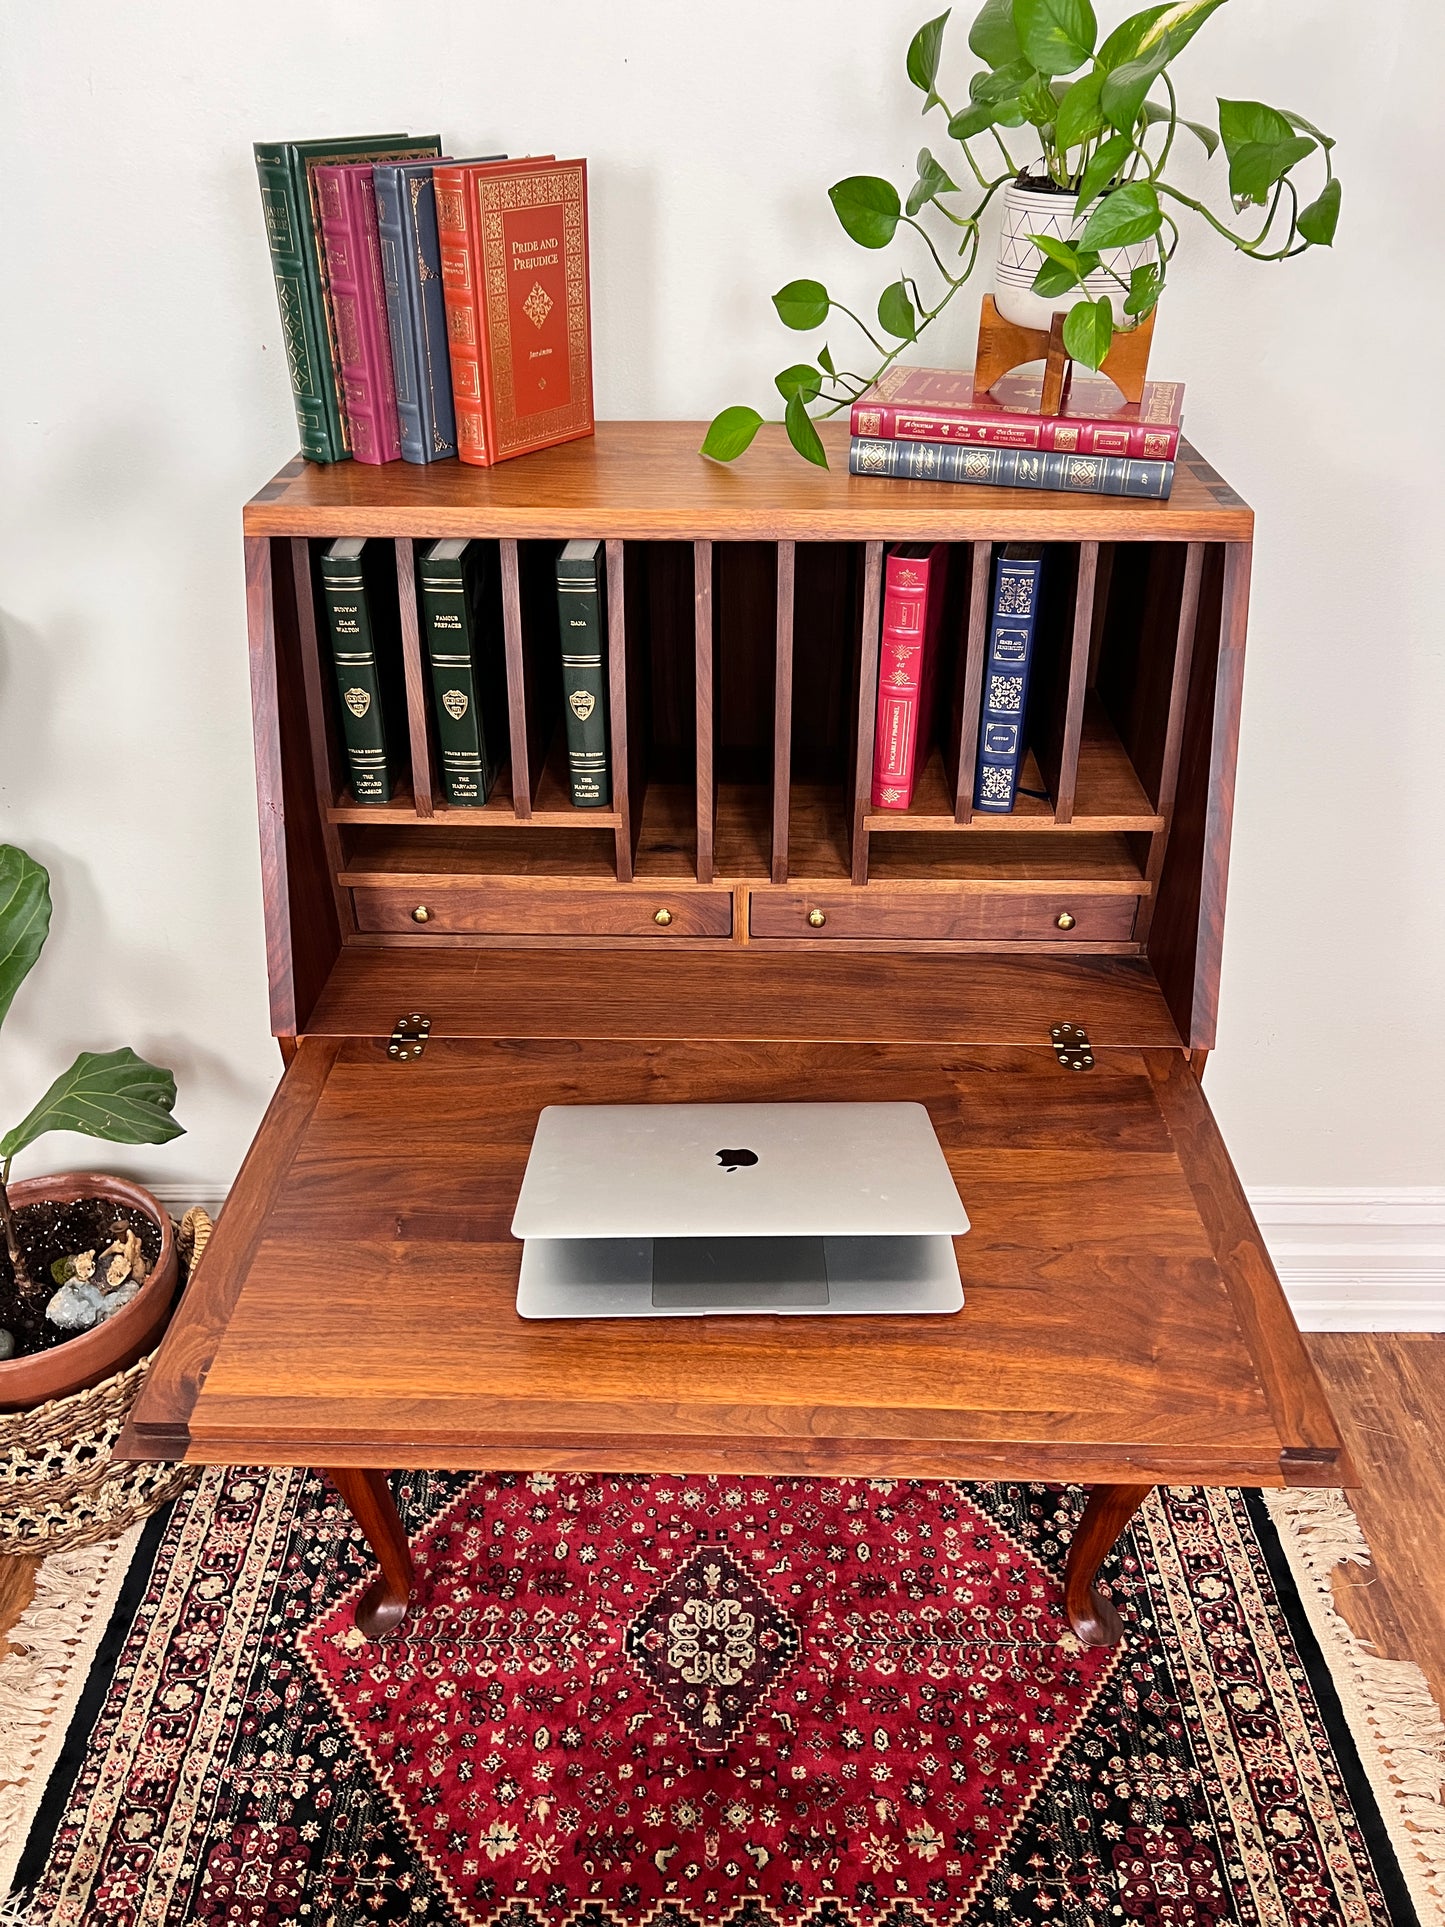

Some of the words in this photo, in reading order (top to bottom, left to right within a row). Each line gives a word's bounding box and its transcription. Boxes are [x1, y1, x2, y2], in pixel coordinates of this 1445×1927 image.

[512, 240, 539, 255] PRIDE
[540, 238, 558, 249] AND
[513, 254, 559, 271] PREJUDICE
